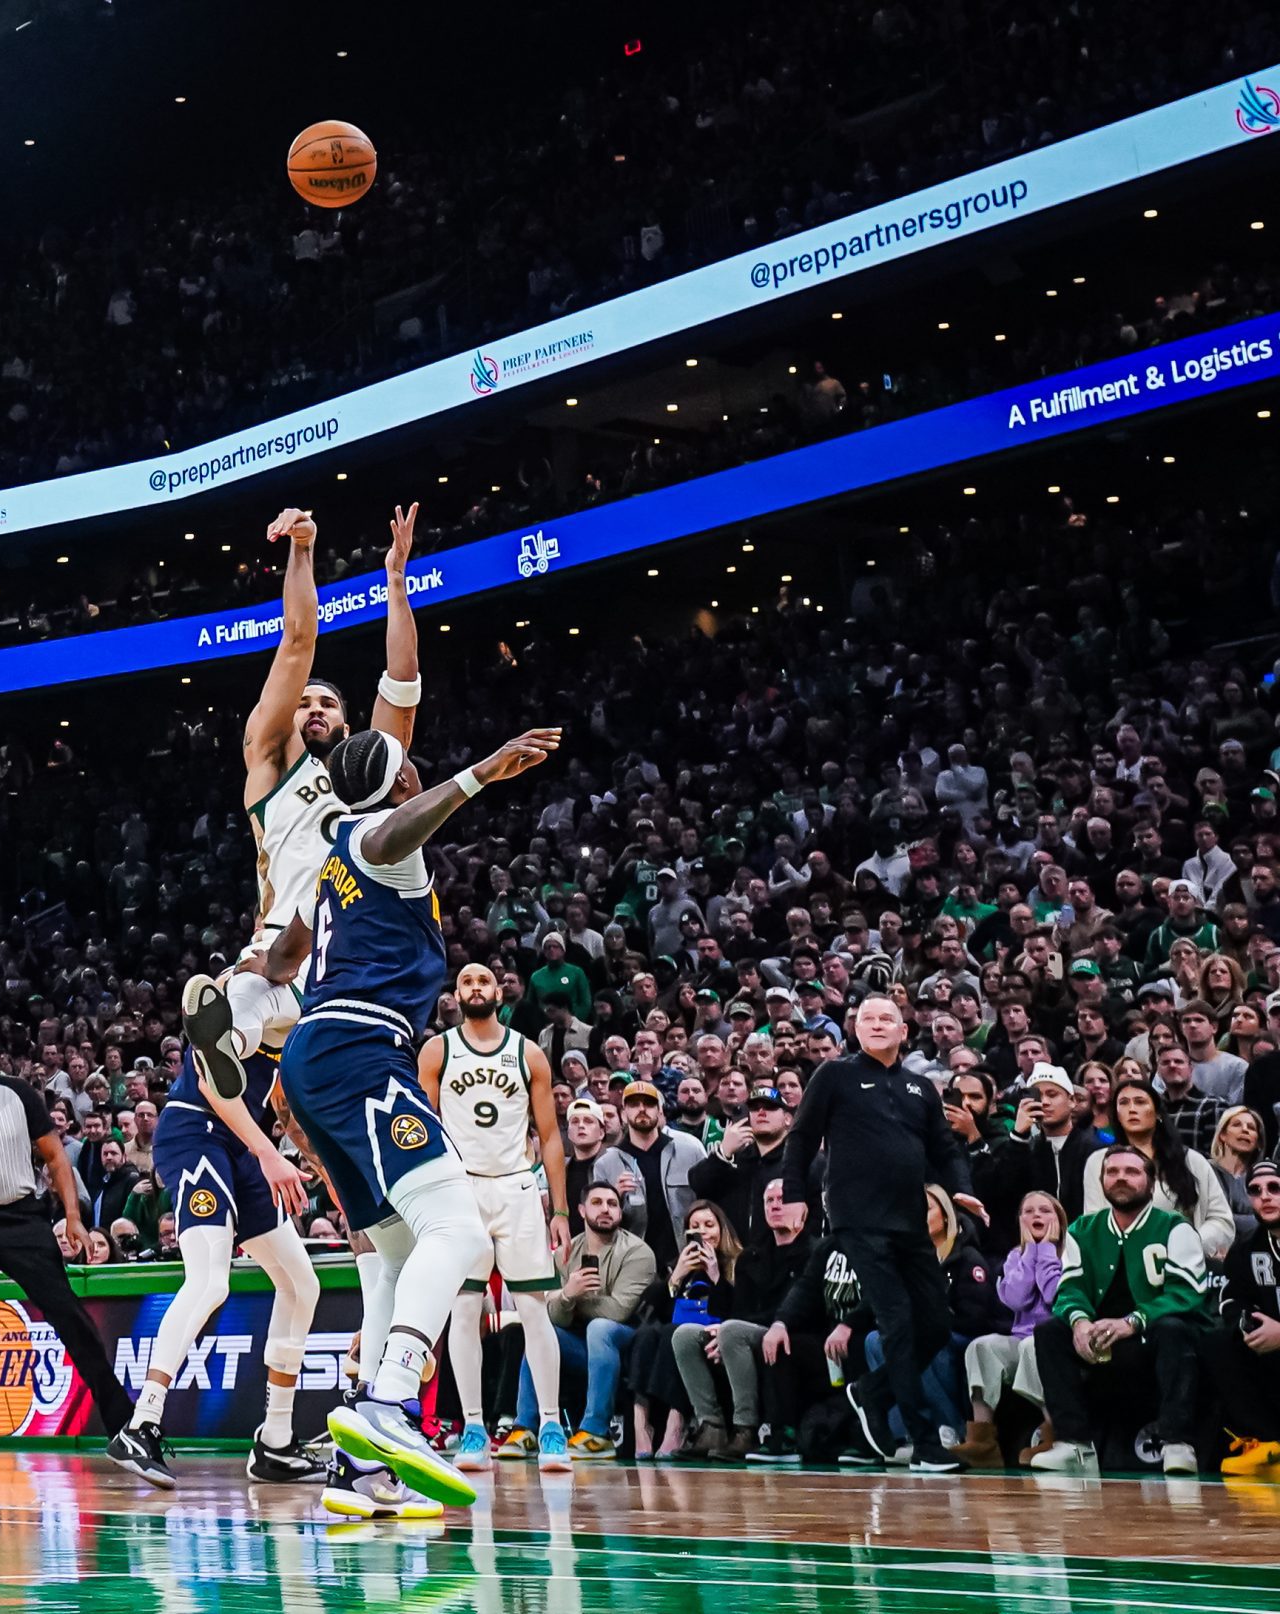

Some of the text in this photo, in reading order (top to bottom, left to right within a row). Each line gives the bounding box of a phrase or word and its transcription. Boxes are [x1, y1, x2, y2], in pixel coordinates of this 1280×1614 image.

[750, 179, 1028, 289] @preppartnersgroup
[503, 330, 594, 371] PREP PARTNERS
[1008, 339, 1273, 429] A Fulfillment & Logistics
[149, 417, 339, 493] @preppartnersgroup
[198, 567, 444, 647] A Fulfillmen ogistics Sla Dunk
[449, 1067, 520, 1099] BOSTON
[473, 1101, 499, 1129] 9
[1142, 1243, 1167, 1287] C
[1251, 1251, 1277, 1286] R
[113, 1334, 254, 1390] NXT
